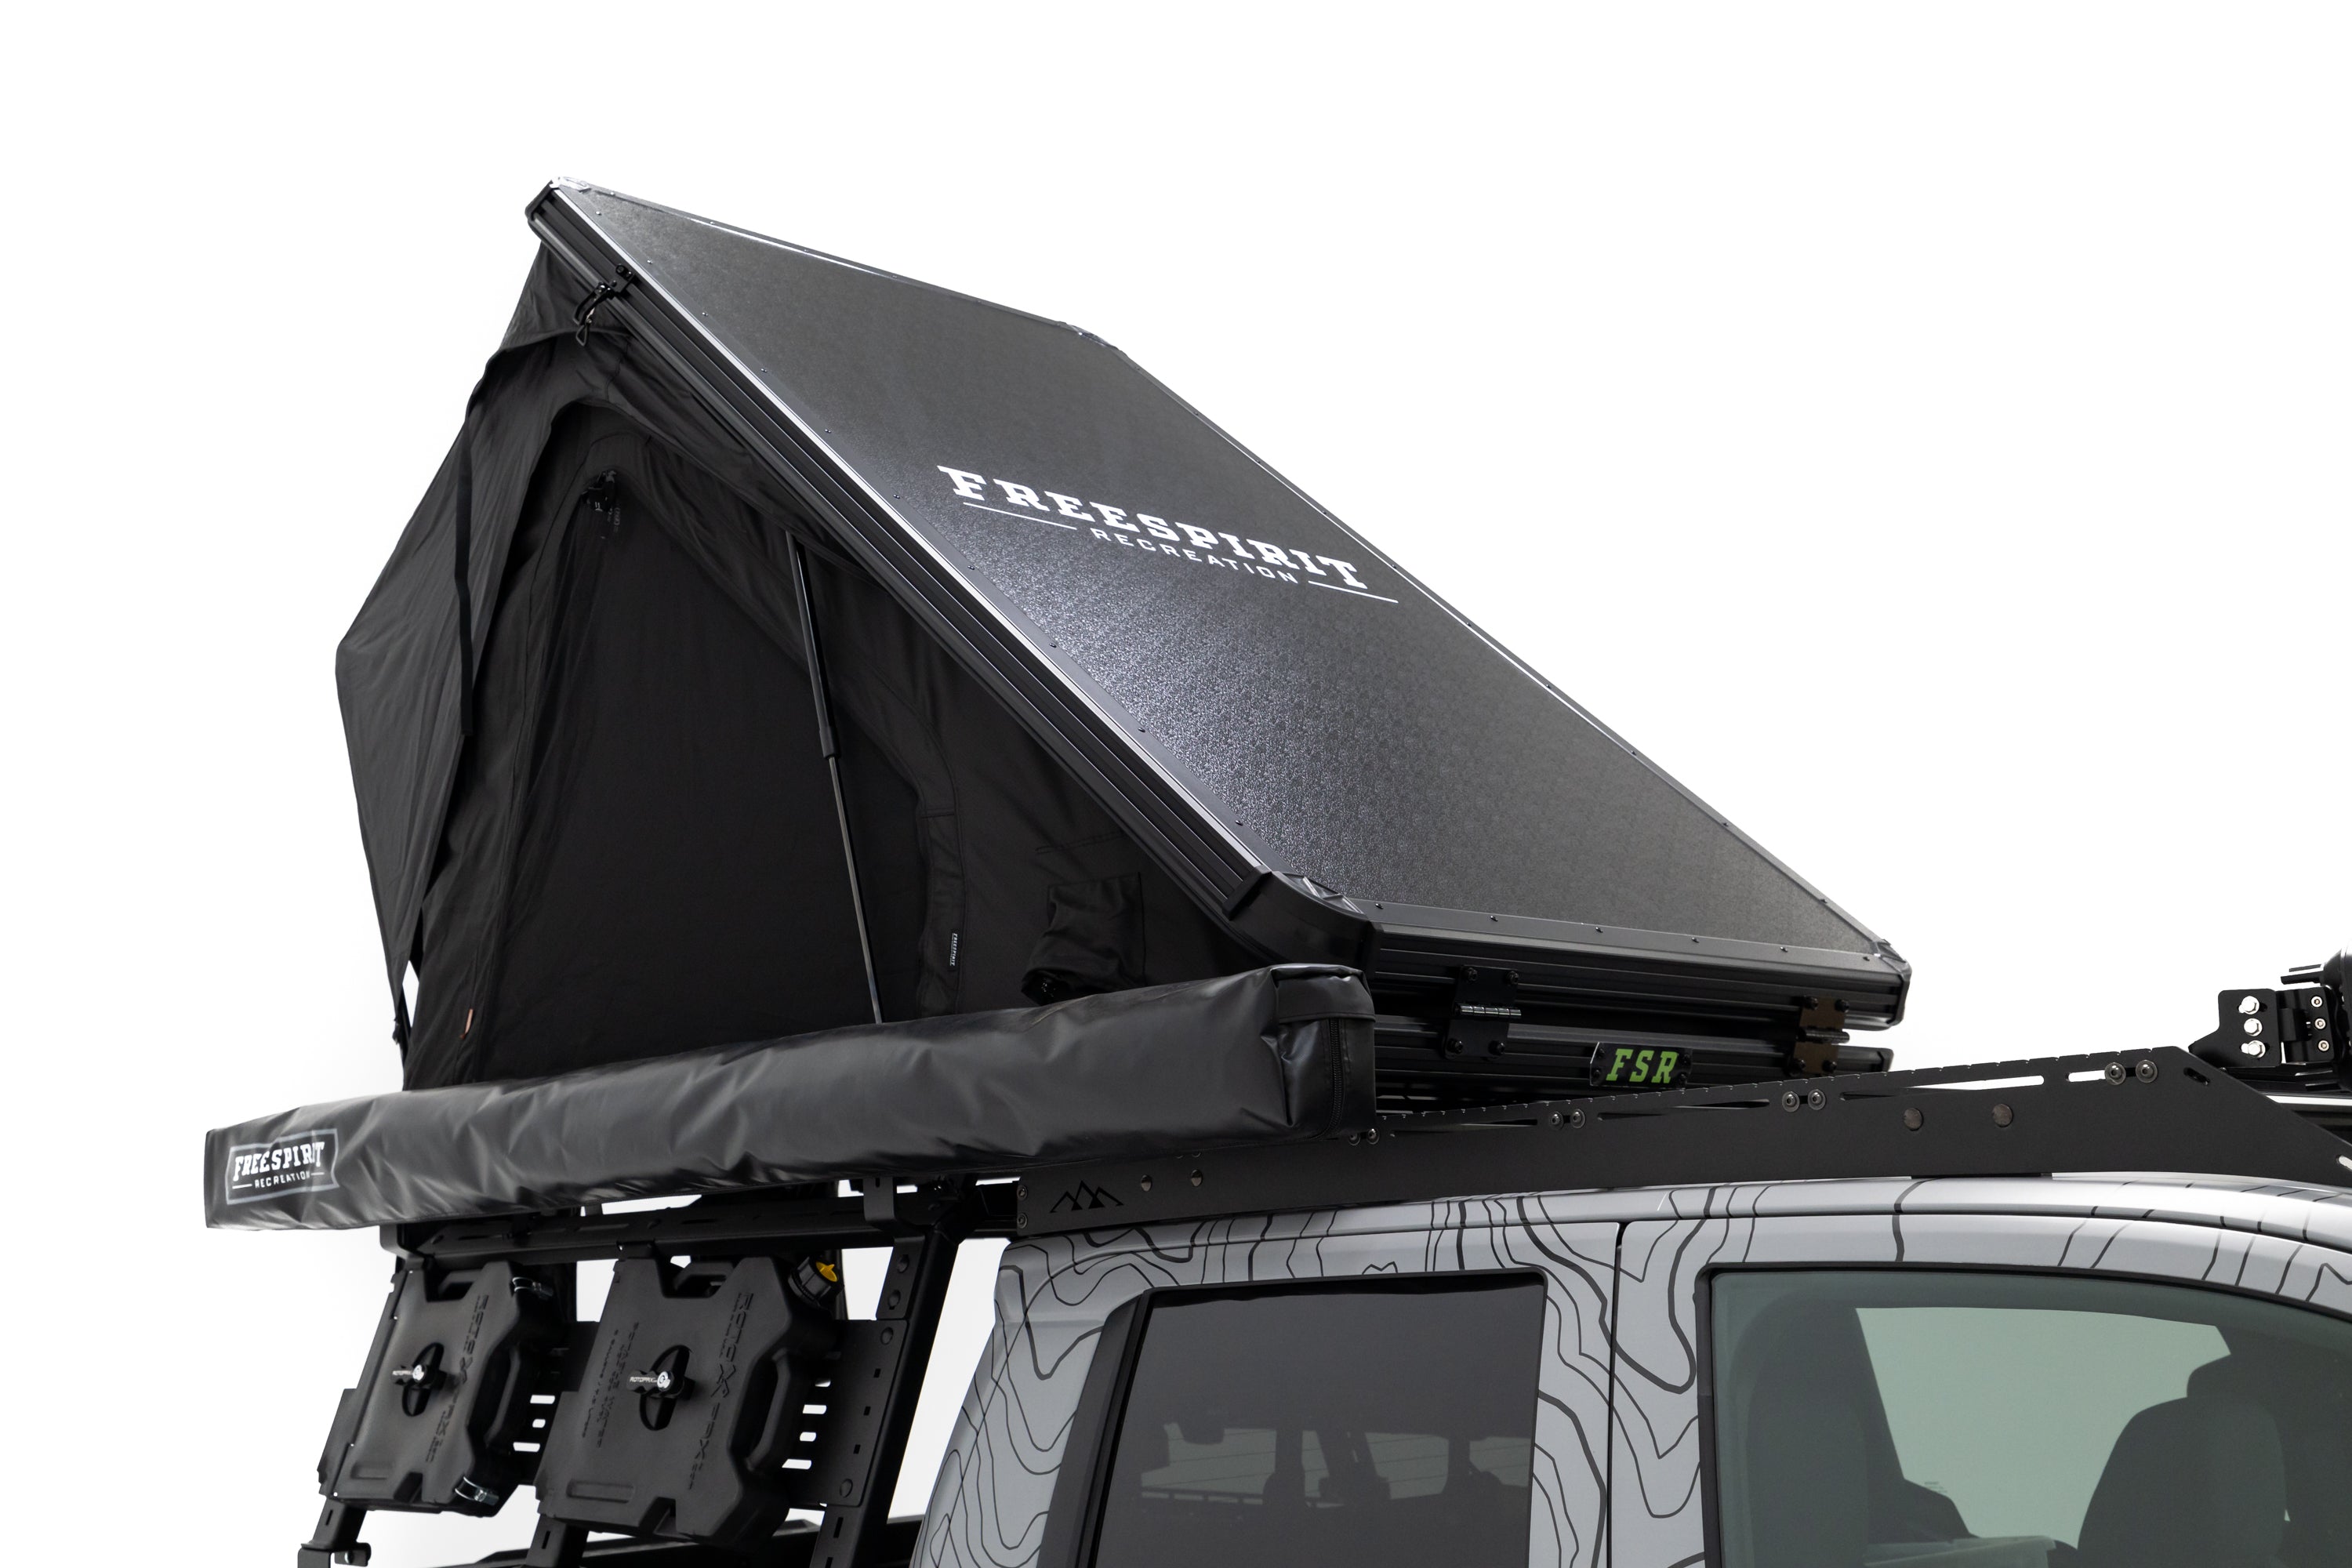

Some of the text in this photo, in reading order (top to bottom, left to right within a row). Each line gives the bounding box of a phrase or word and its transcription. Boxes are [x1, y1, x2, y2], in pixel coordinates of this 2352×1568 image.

[937, 465, 1367, 589] FREESPIRIT
[1090, 528, 1298, 584] RECREATION
[1606, 1049, 1678, 1083] FSR
[233, 1142, 325, 1181] FREESPIRIT
[254, 1171, 310, 1189] RECREATION
